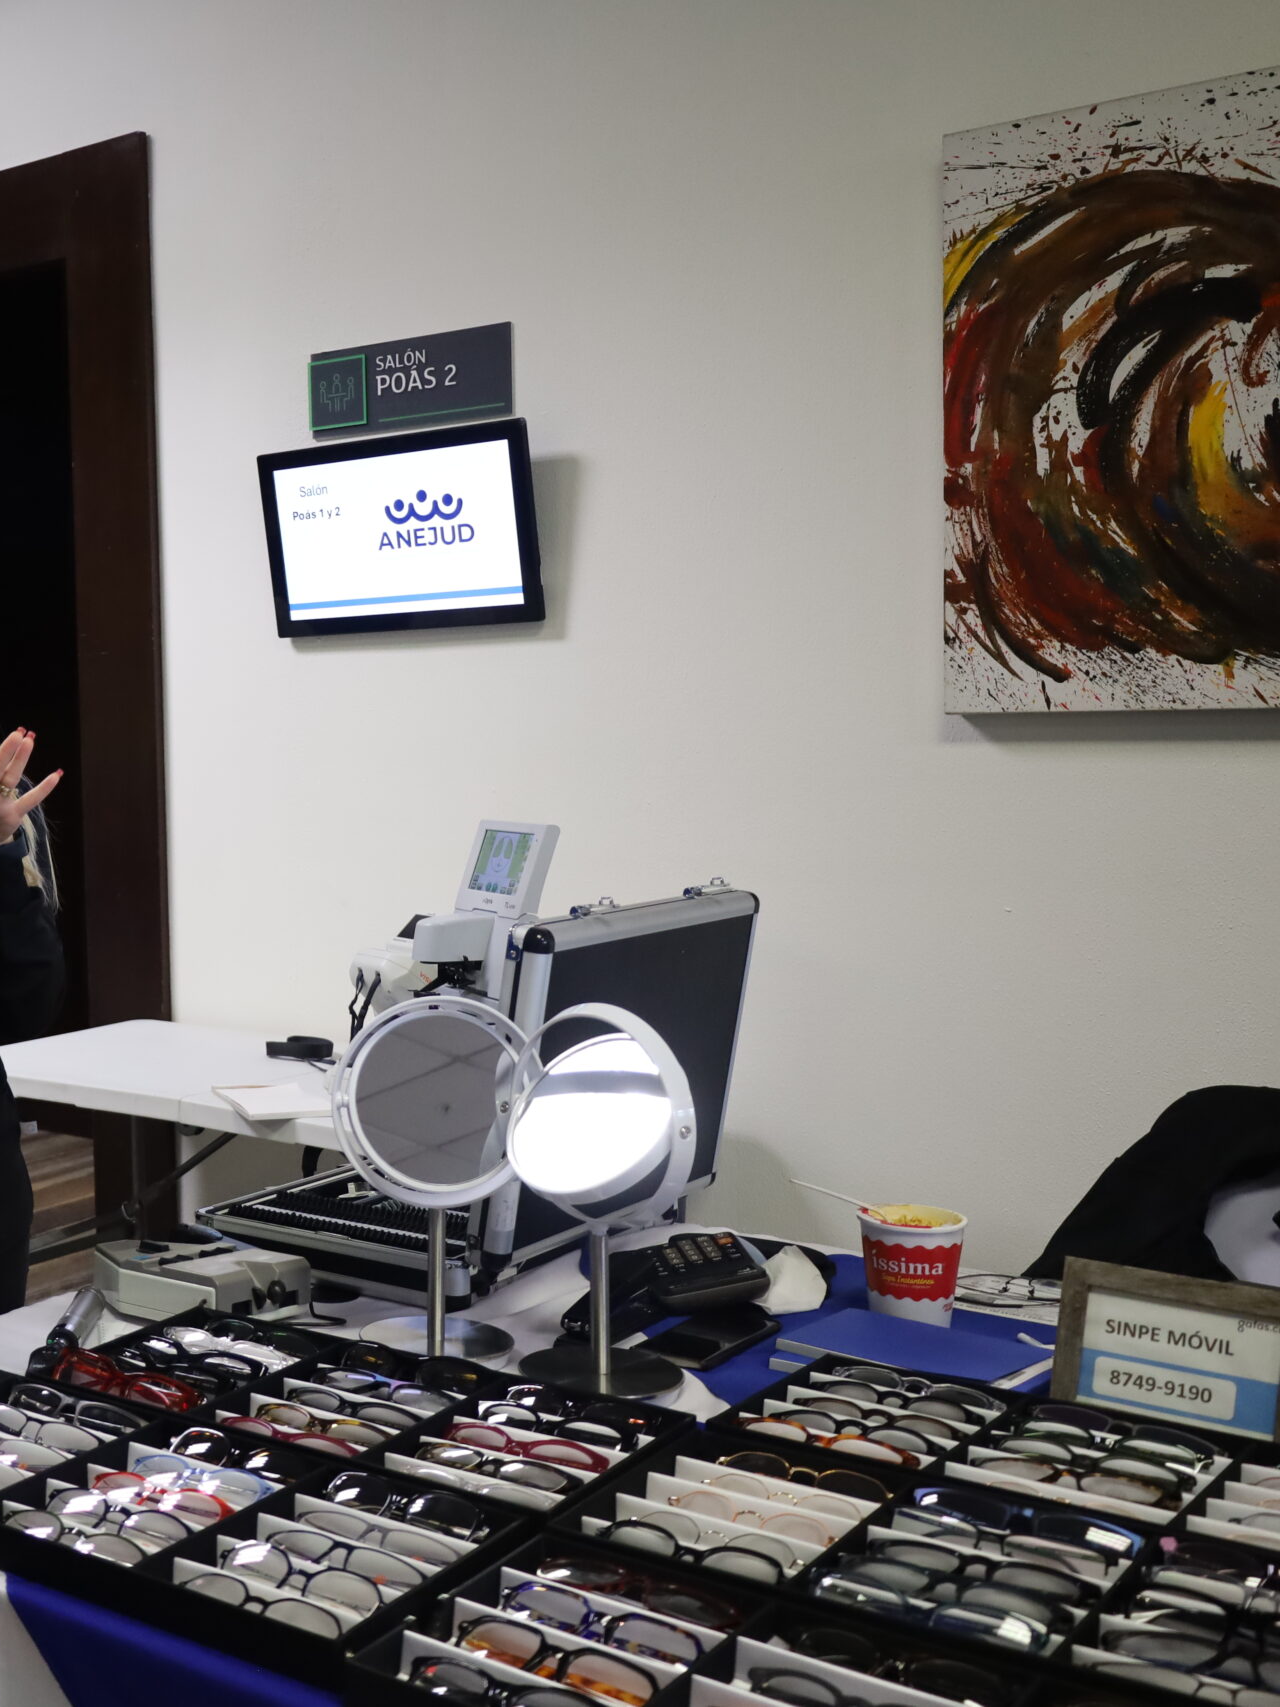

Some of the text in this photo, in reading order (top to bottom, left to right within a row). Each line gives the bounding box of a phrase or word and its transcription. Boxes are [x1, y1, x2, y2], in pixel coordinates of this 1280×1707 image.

[375, 348, 426, 371] SALÓN
[375, 363, 457, 396] POÁS 2
[299, 484, 329, 498] Salón
[292, 506, 341, 521] Poás 1 y 2
[378, 523, 475, 551] ANEJUD
[1105, 1318, 1235, 1357] SINPE MÓVIL
[1109, 1369, 1213, 1403] 8749-9190
